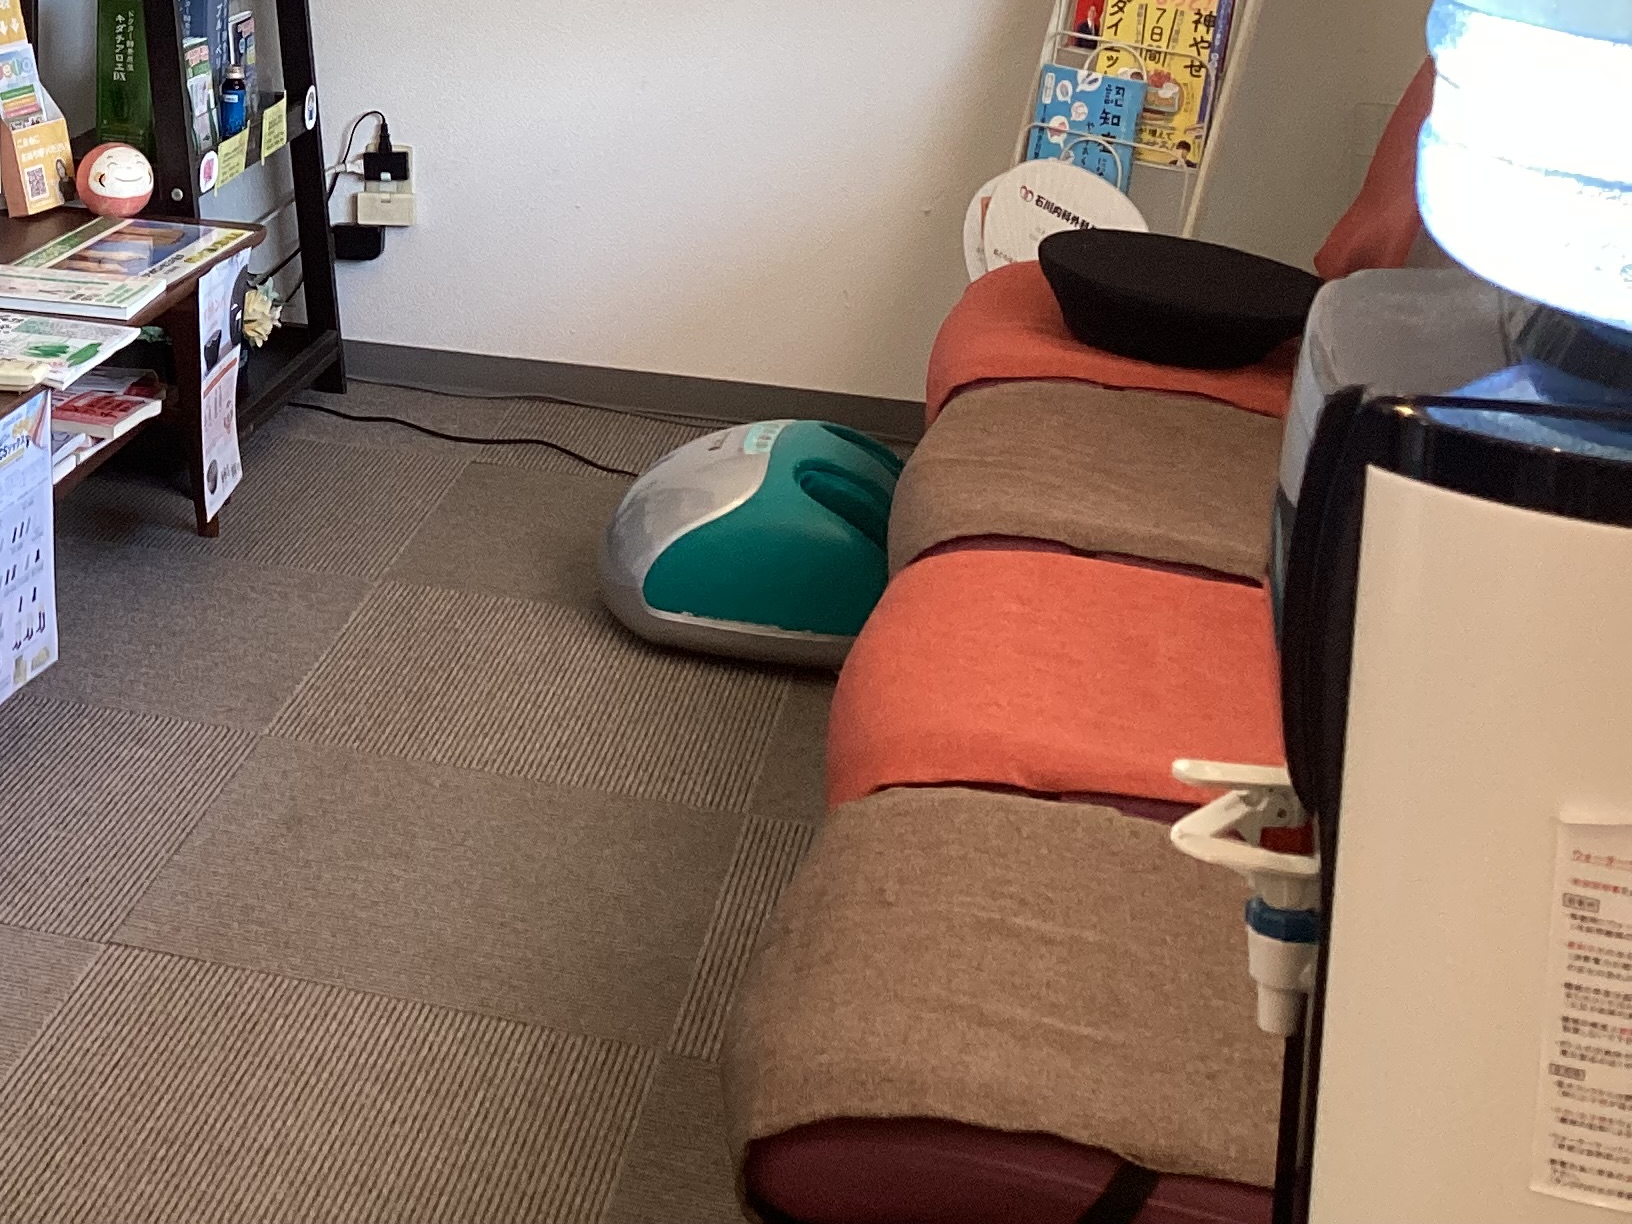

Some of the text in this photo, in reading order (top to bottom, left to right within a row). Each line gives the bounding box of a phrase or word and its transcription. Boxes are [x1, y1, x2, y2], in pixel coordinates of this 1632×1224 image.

[1144, 7, 1167, 62] 7日間
[1183, 9, 1218, 79] 神やせ
[1035, 194, 1097, 230] 石川内科外科
